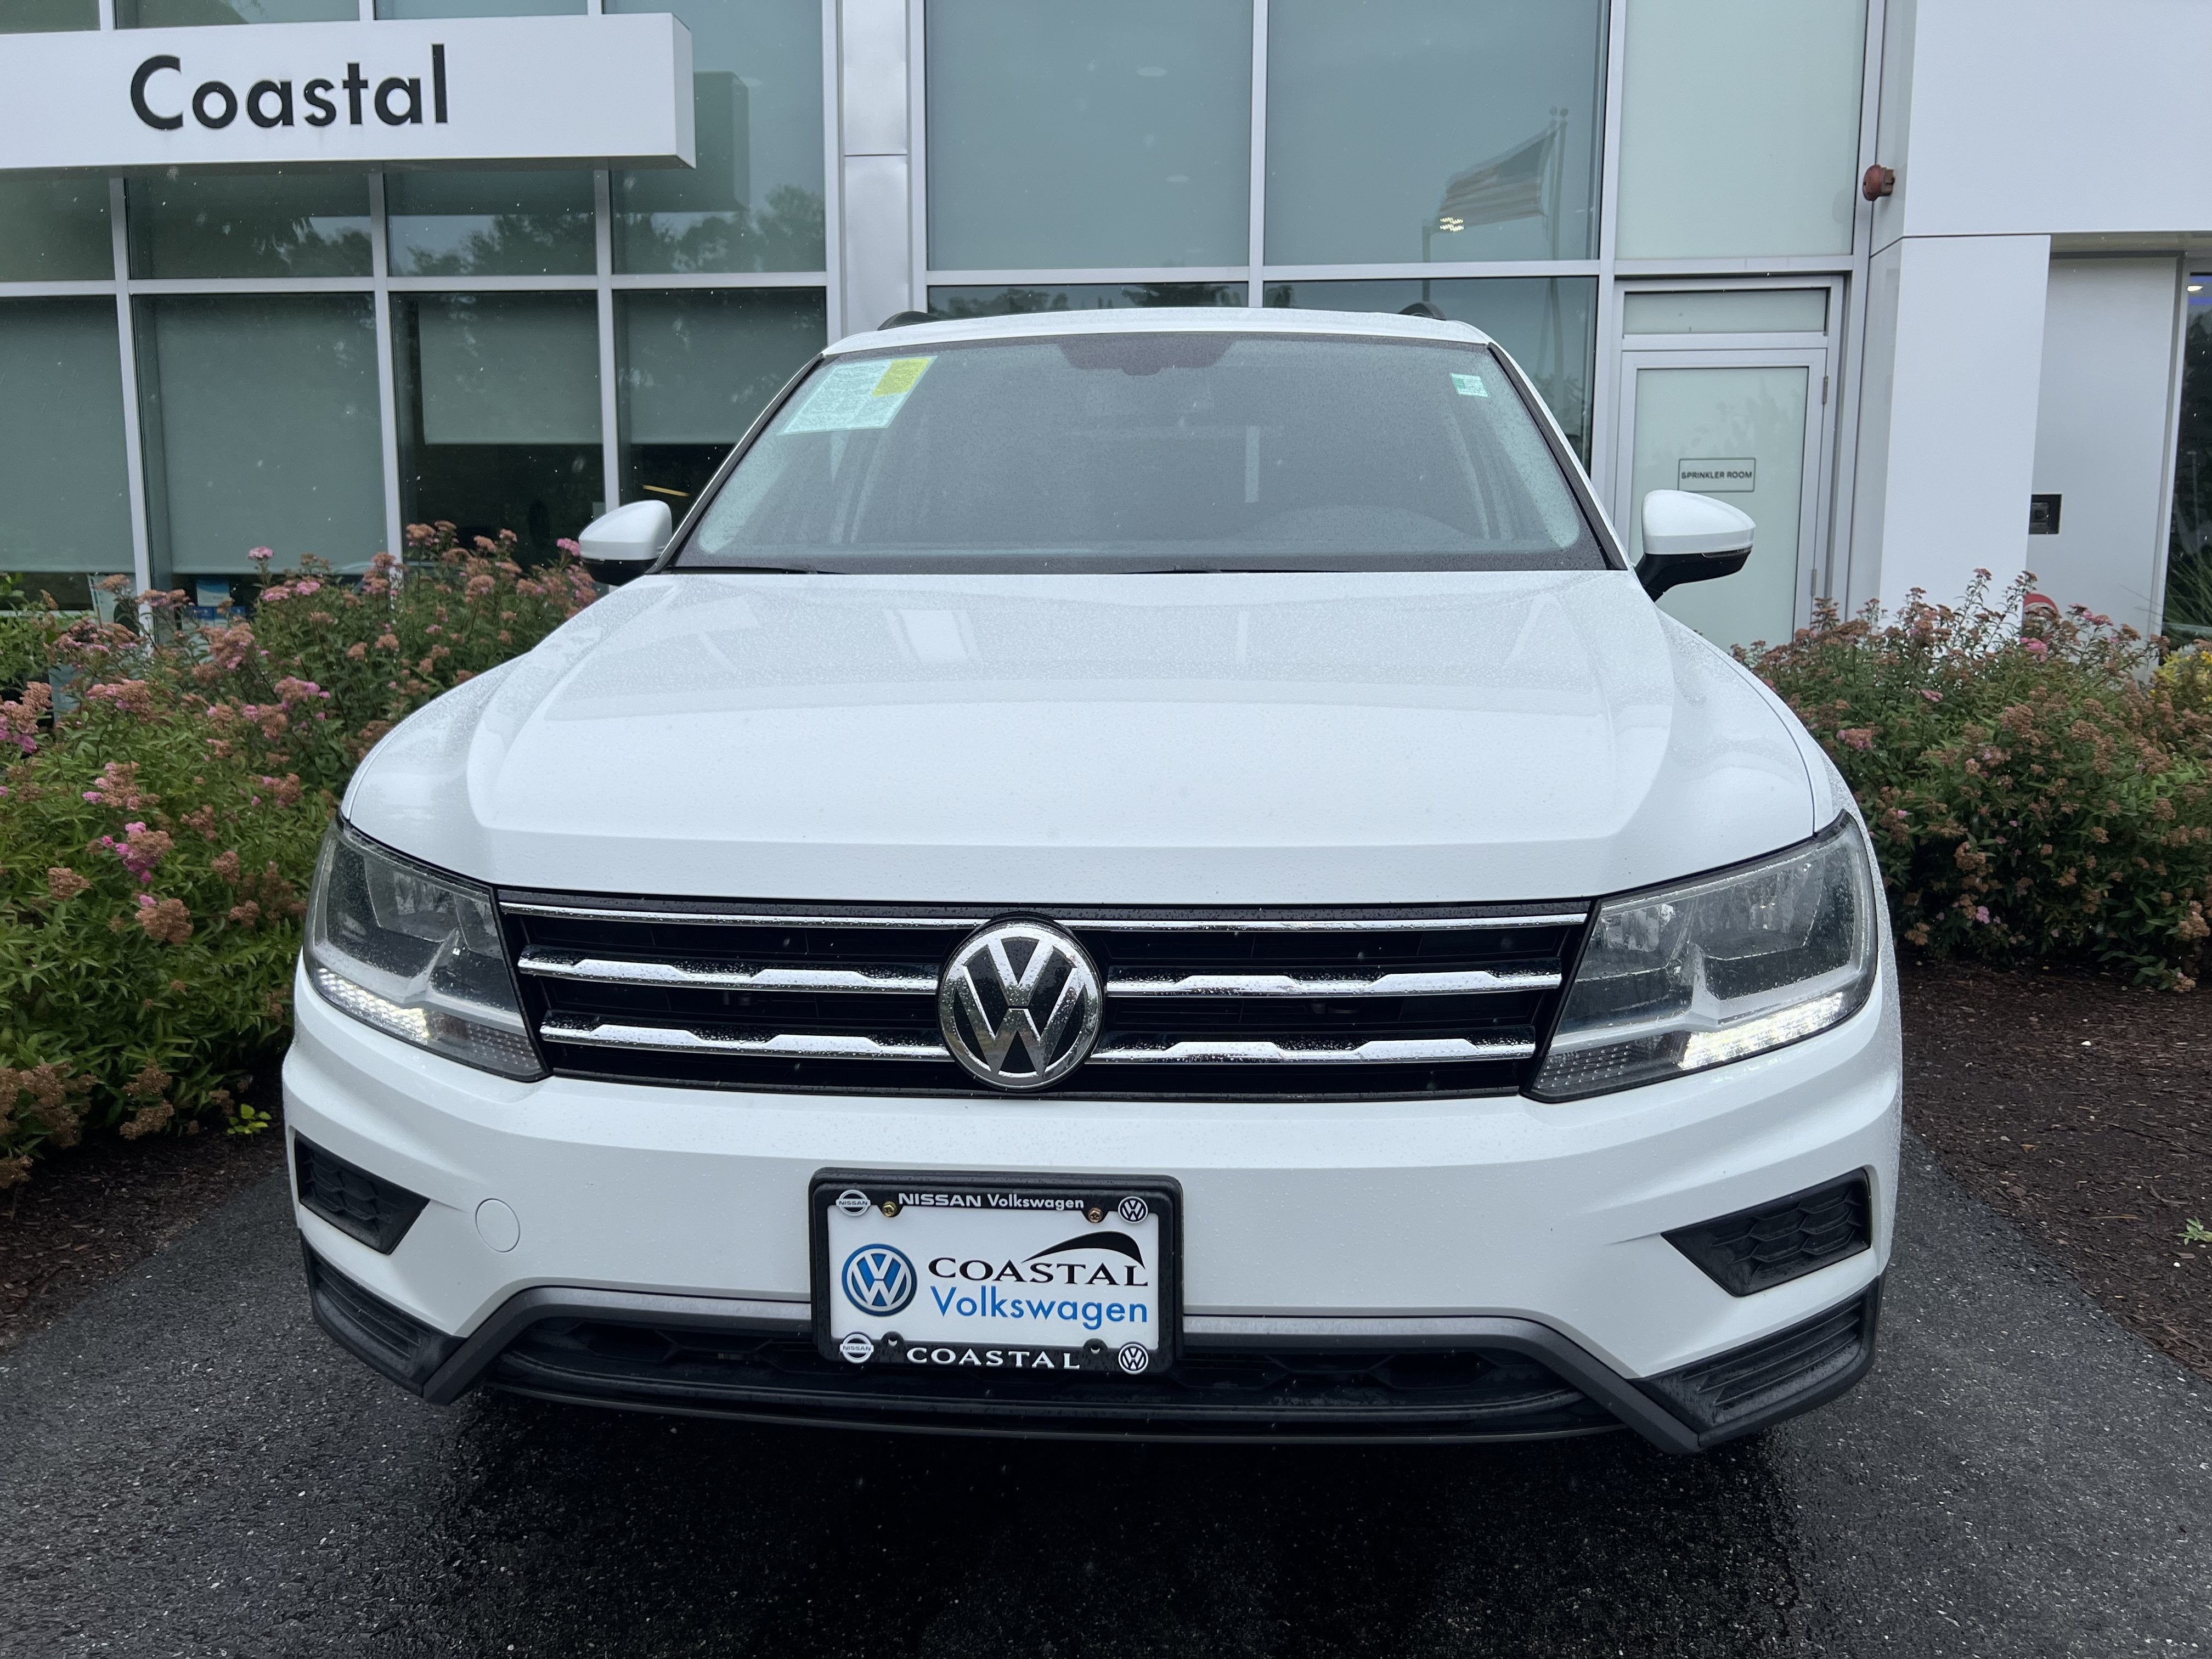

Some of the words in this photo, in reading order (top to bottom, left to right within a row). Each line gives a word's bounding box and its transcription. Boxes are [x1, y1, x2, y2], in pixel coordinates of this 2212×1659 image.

[130, 43, 449, 131] Coastal
[1681, 471, 1725, 479] SPRINKLER
[1726, 470, 1752, 479] ROOM
[898, 1193, 981, 1207] NISSAN
[987, 1194, 1084, 1211] Volkswagen
[928, 1257, 1148, 1287] COASTAL
[930, 1285, 1147, 1330] Volkswagen
[906, 1347, 1080, 1369] COASTAL
